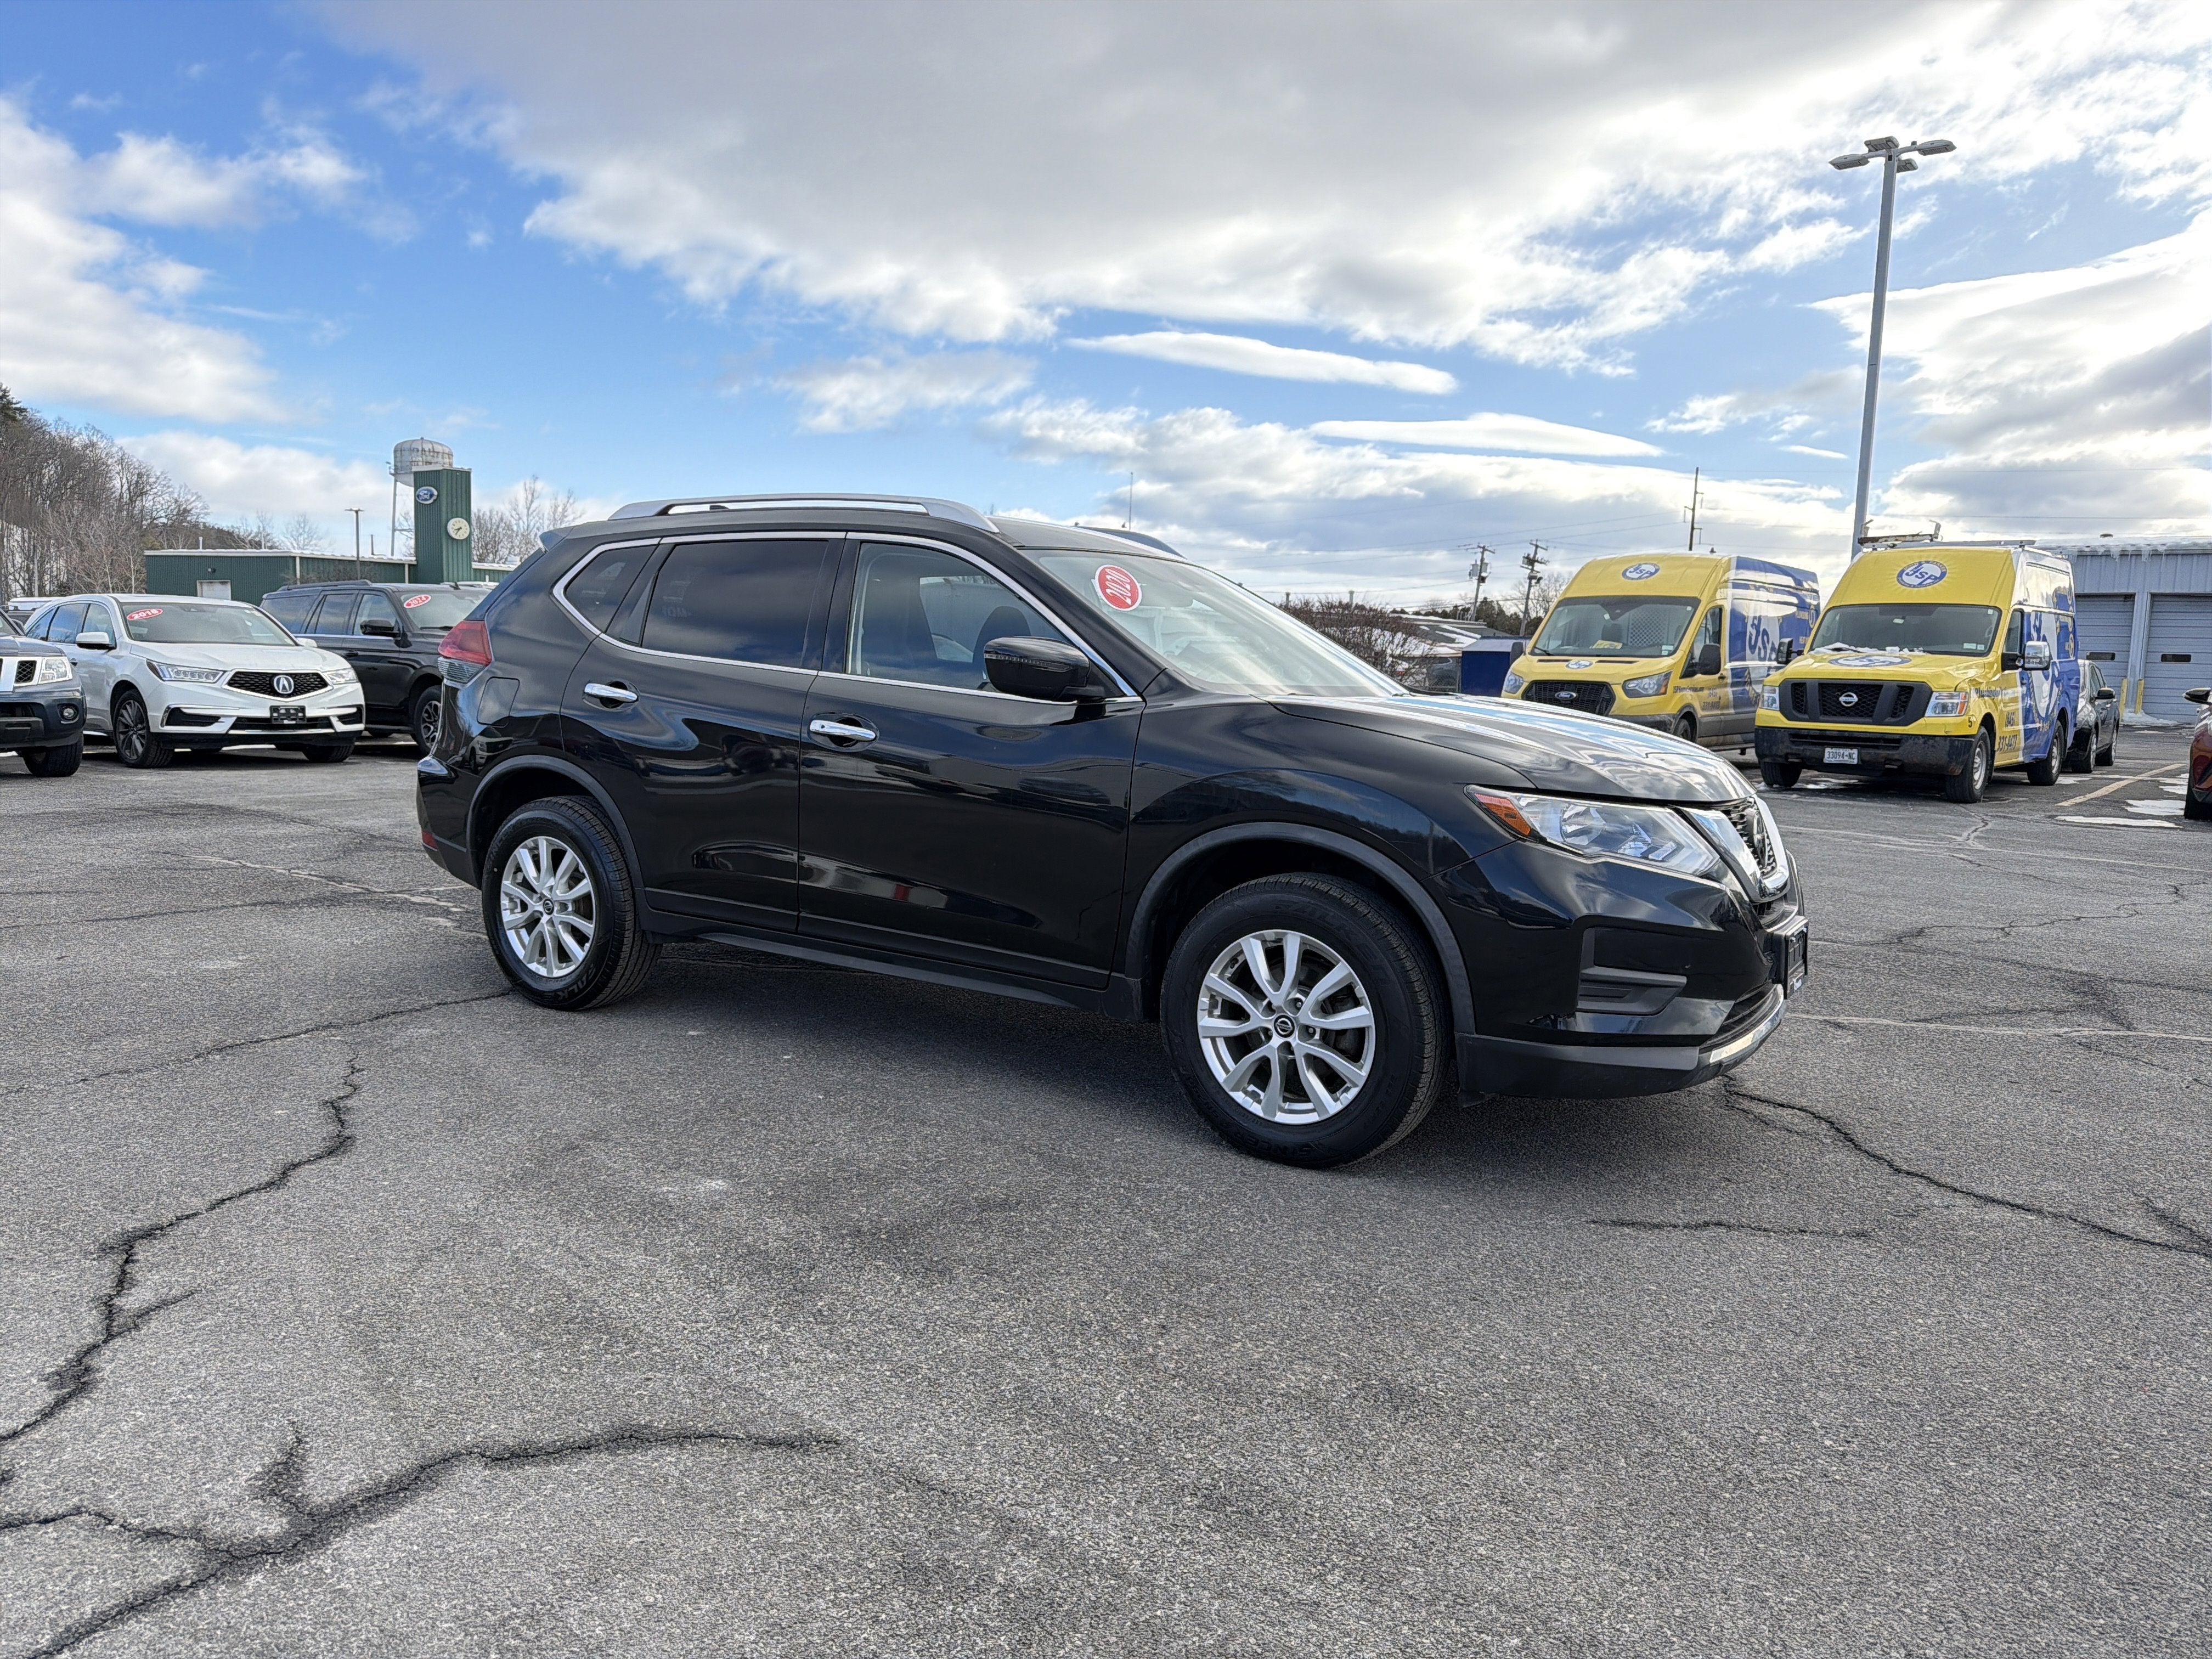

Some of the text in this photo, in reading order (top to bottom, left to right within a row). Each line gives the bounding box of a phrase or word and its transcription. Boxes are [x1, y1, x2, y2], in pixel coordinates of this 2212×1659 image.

[1104, 568, 1132, 605] 2020
[408, 596, 426, 607] 2024
[131, 608, 157, 620] 2018
[1968, 717, 1973, 728] 5
